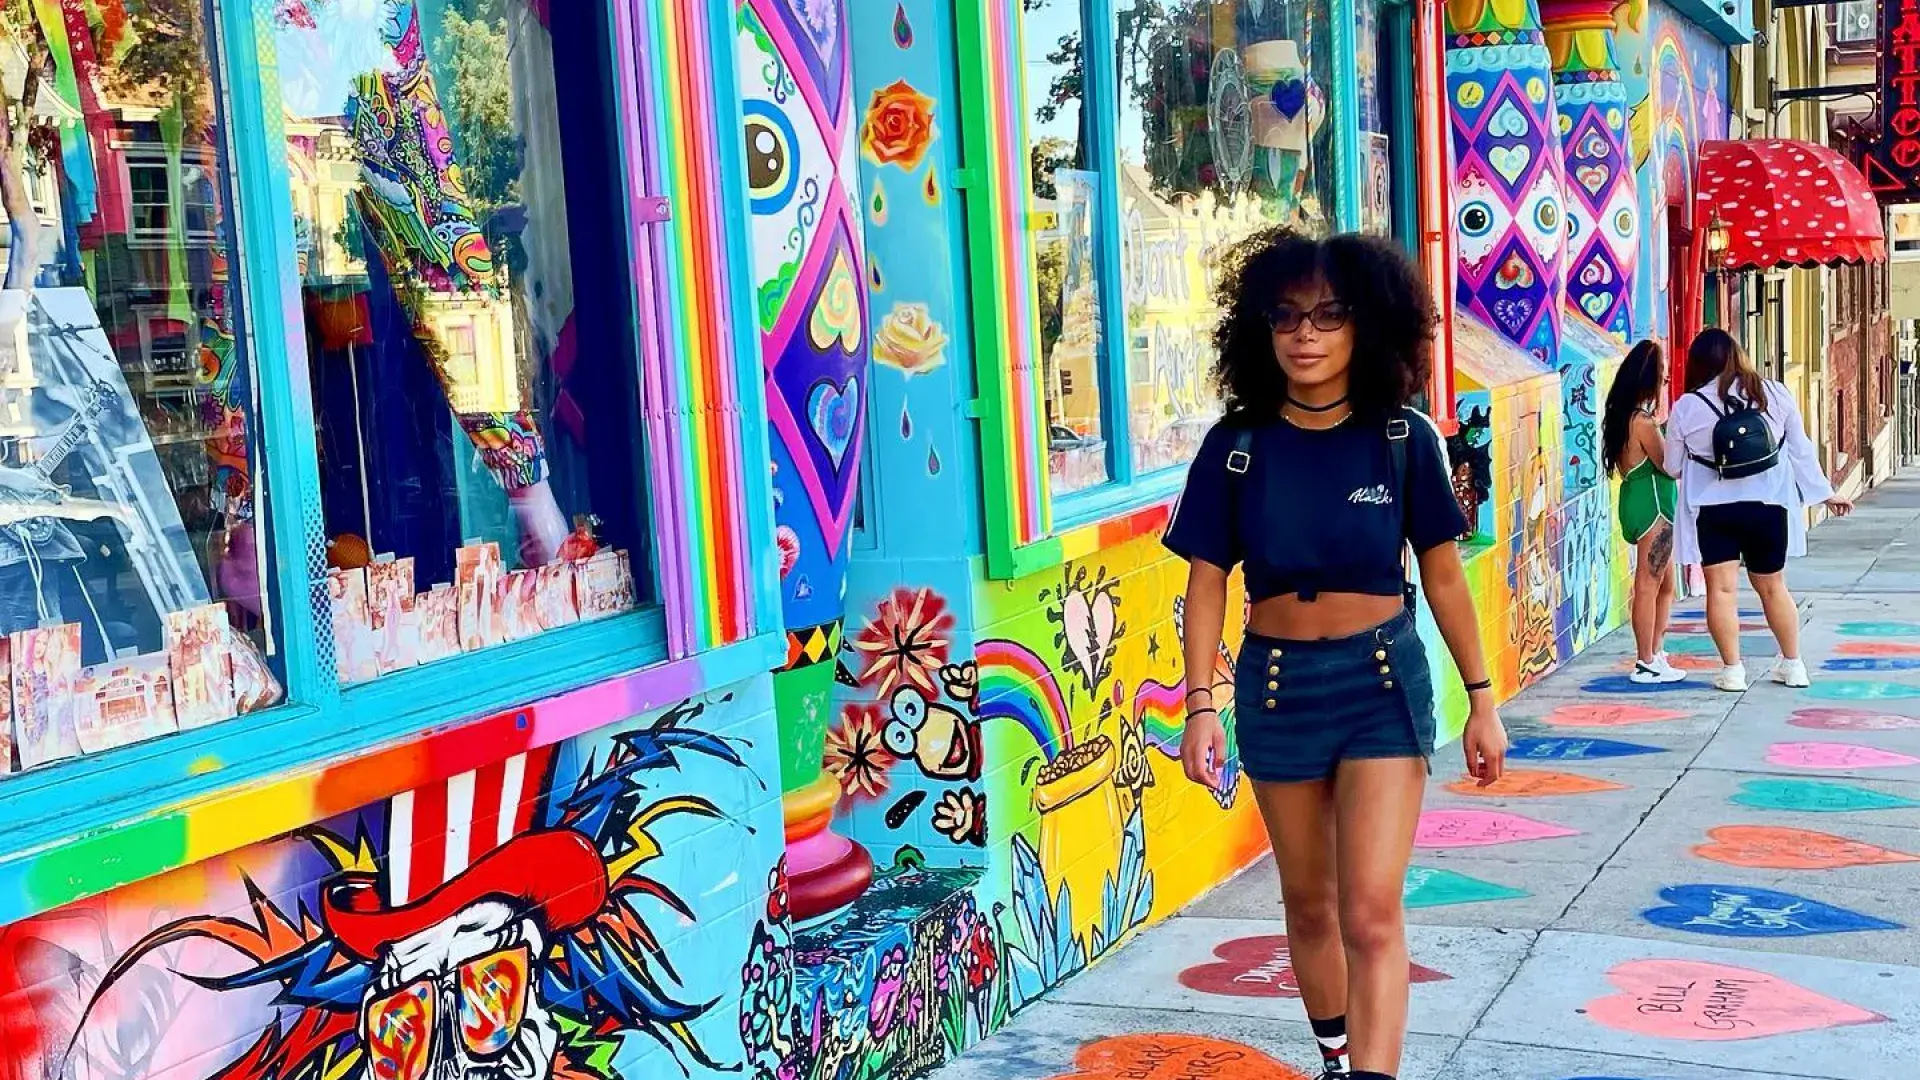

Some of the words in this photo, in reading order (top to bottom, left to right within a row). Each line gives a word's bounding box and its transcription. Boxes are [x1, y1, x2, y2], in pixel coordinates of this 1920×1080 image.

[1891, 0, 1920, 167] ATTOO
[1694, 979, 1770, 1030] GRAHAM
[1116, 1042, 1203, 1079] BLACK
